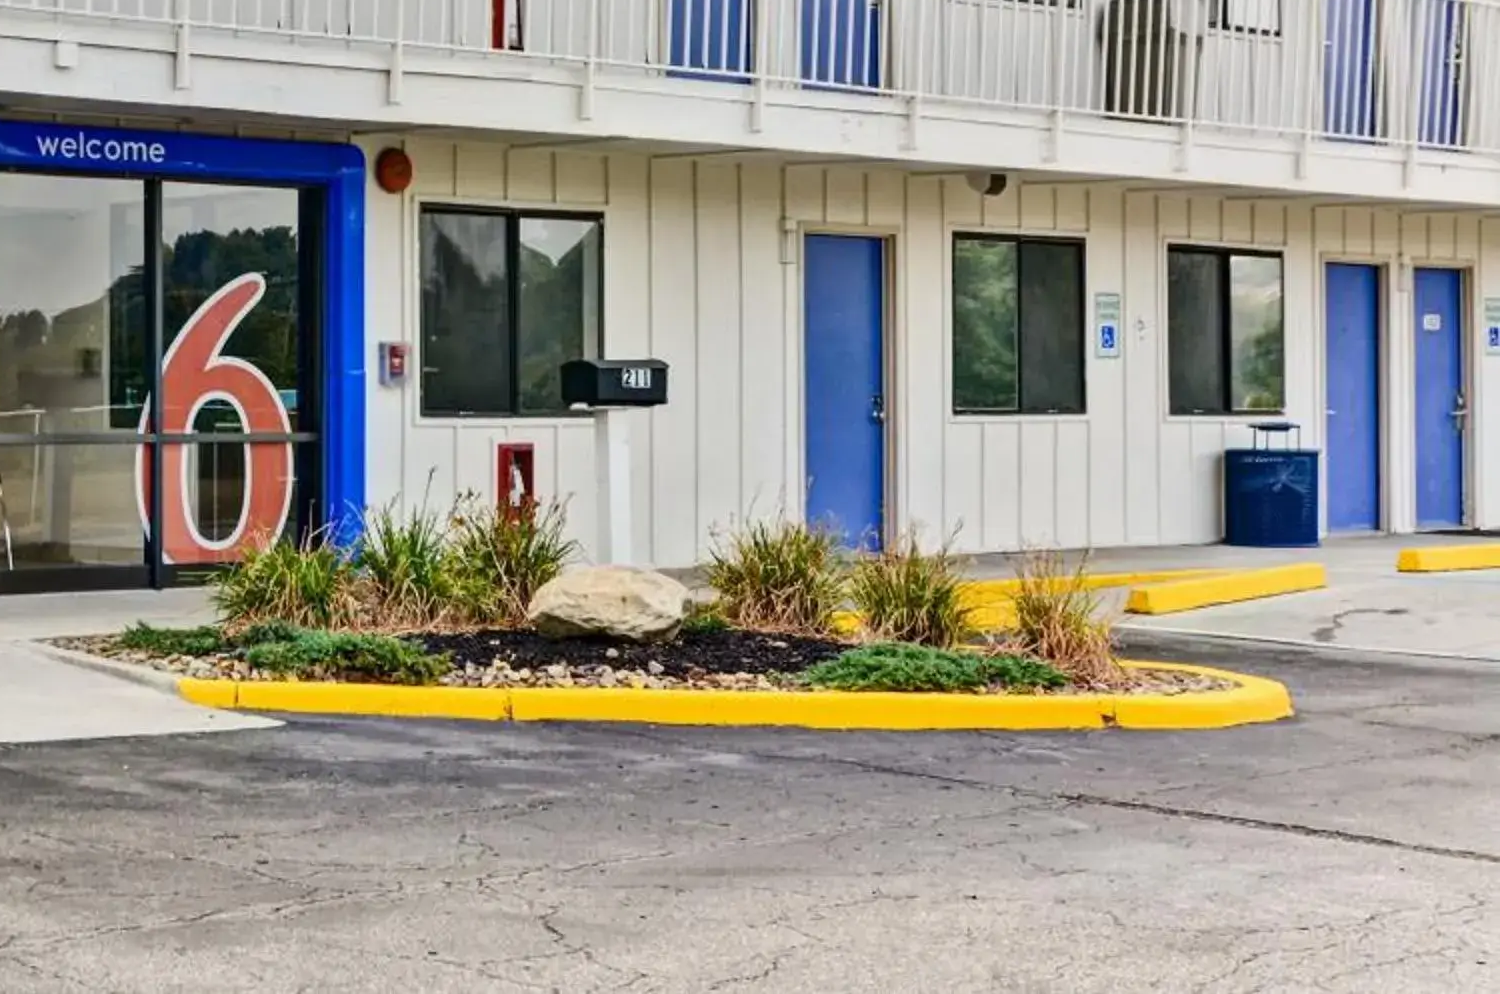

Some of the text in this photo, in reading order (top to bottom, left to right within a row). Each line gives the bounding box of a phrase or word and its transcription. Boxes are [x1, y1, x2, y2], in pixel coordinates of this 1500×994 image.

[36, 131, 165, 163] welcome
[622, 367, 651, 388] 211
[135, 271, 294, 564] 6
